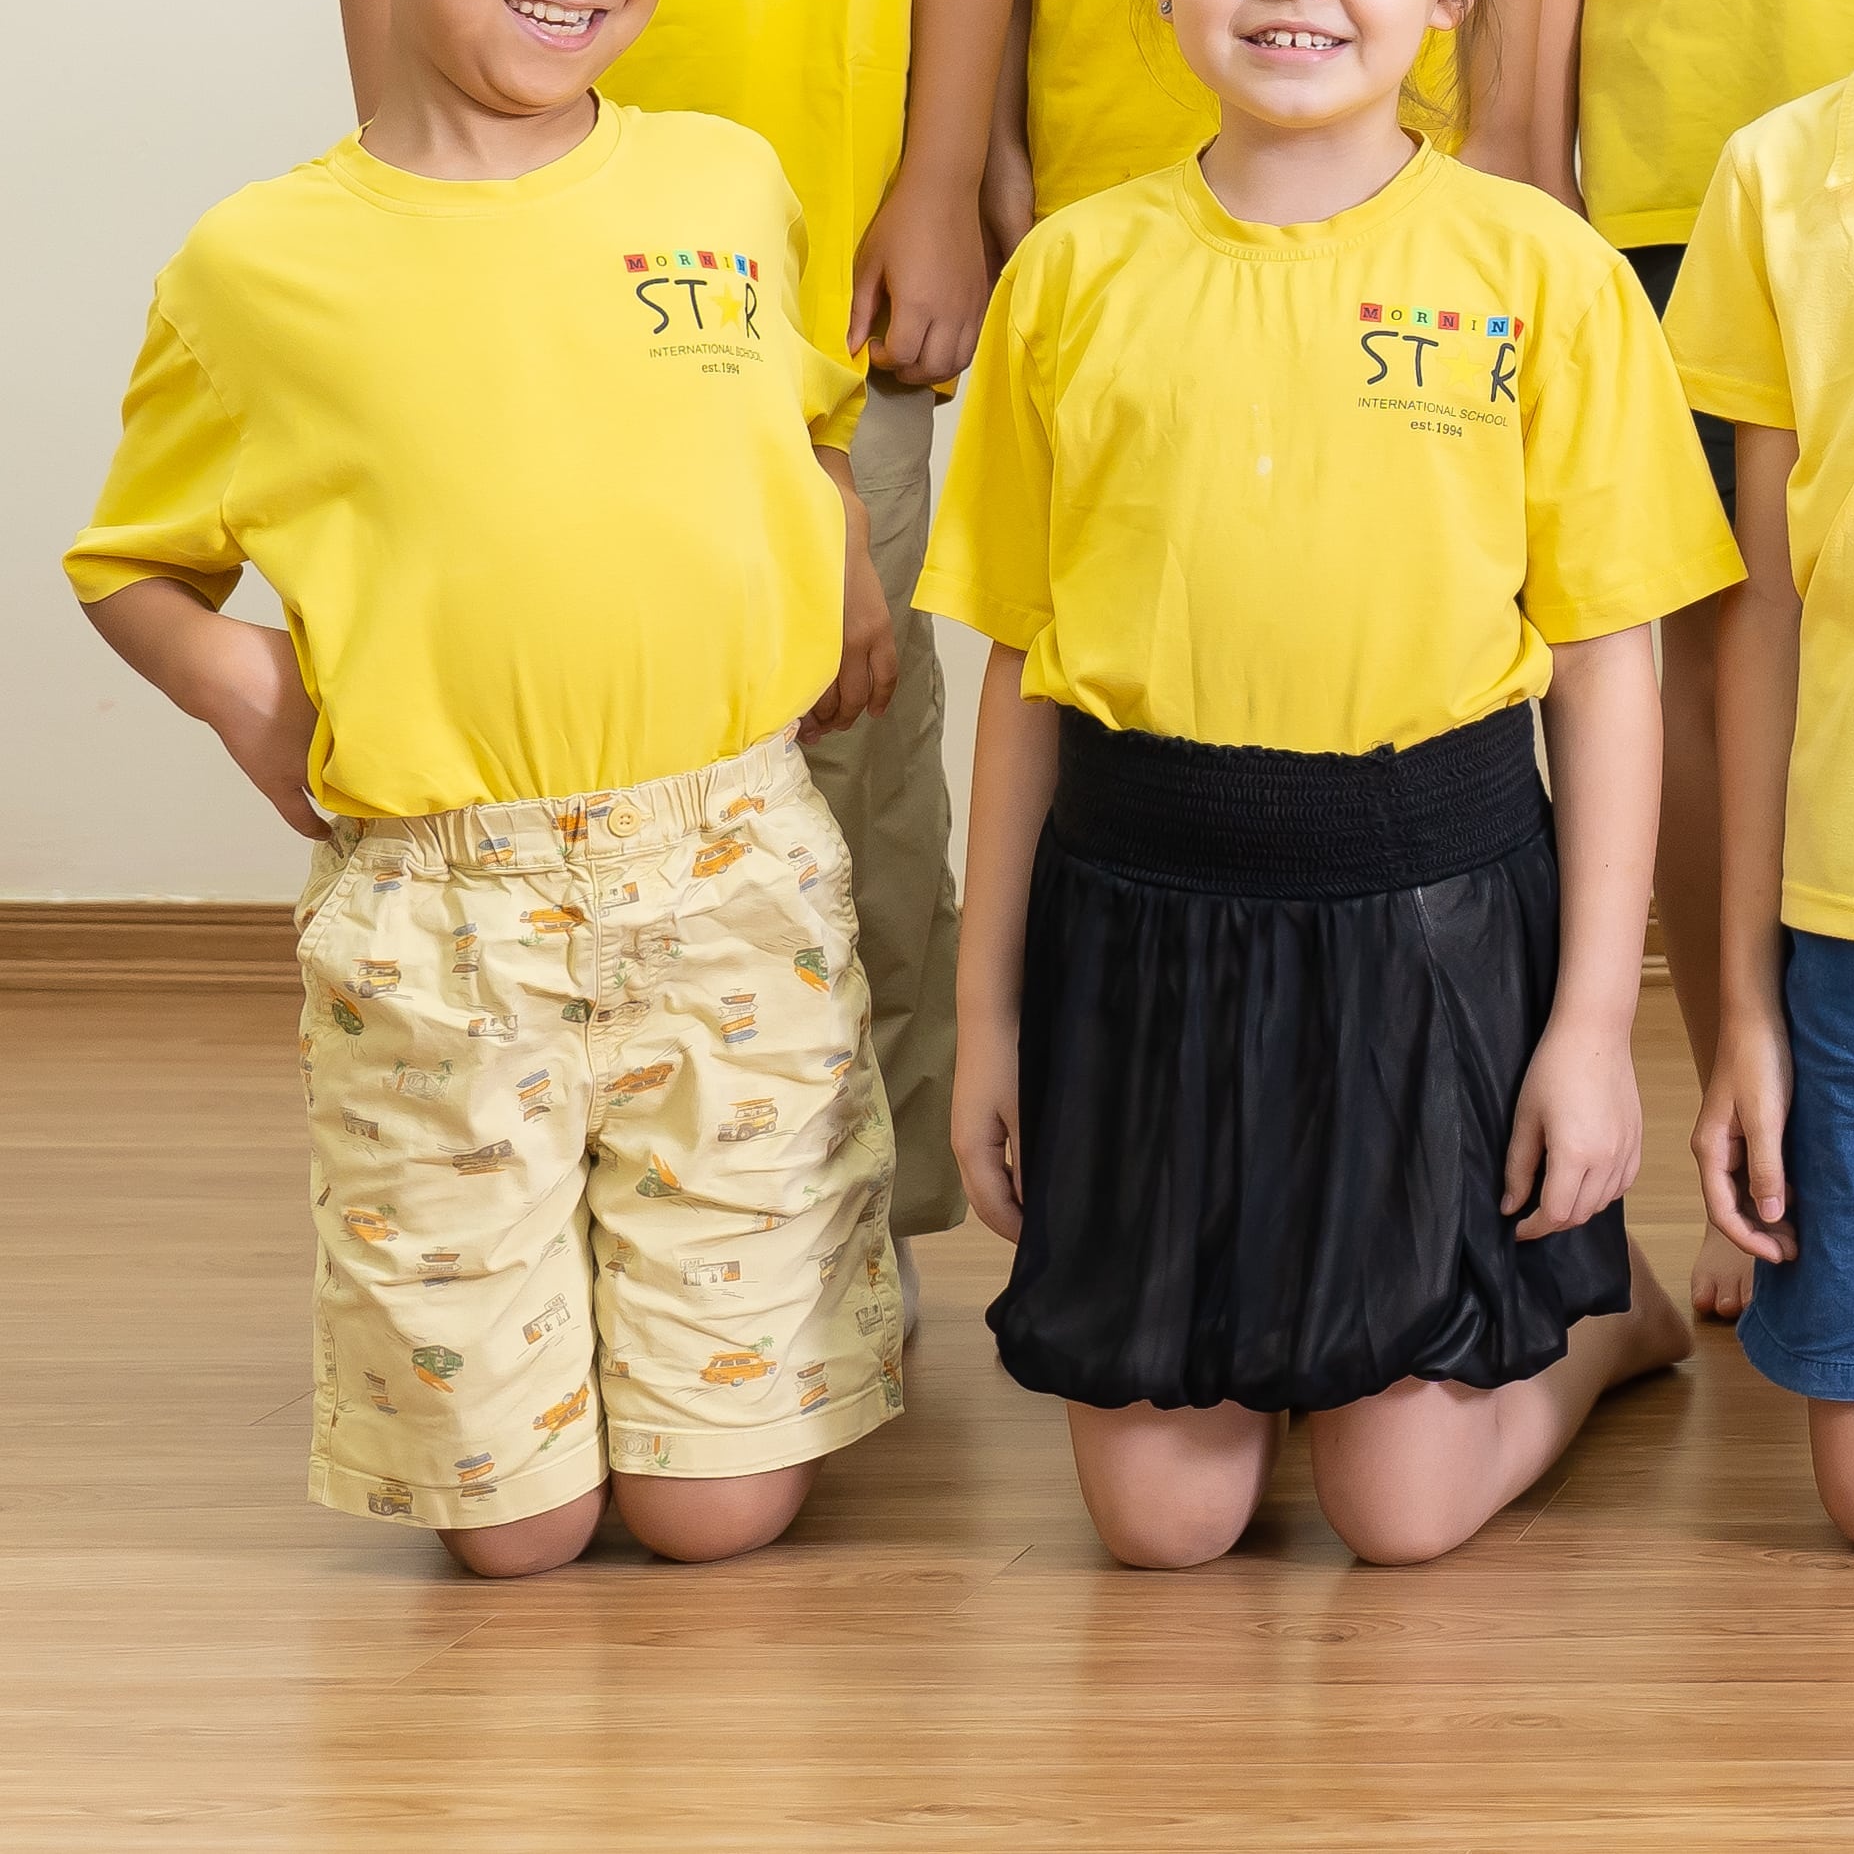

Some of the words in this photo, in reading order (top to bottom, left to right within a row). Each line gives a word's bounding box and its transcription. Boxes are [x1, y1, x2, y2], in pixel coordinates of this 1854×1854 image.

[626, 252, 758, 280] MORNING
[650, 343, 735, 359] INTERNATIONAL
[1358, 397, 1457, 418] INTERNATIONAL
[1459, 408, 1509, 427] SCHOOL
